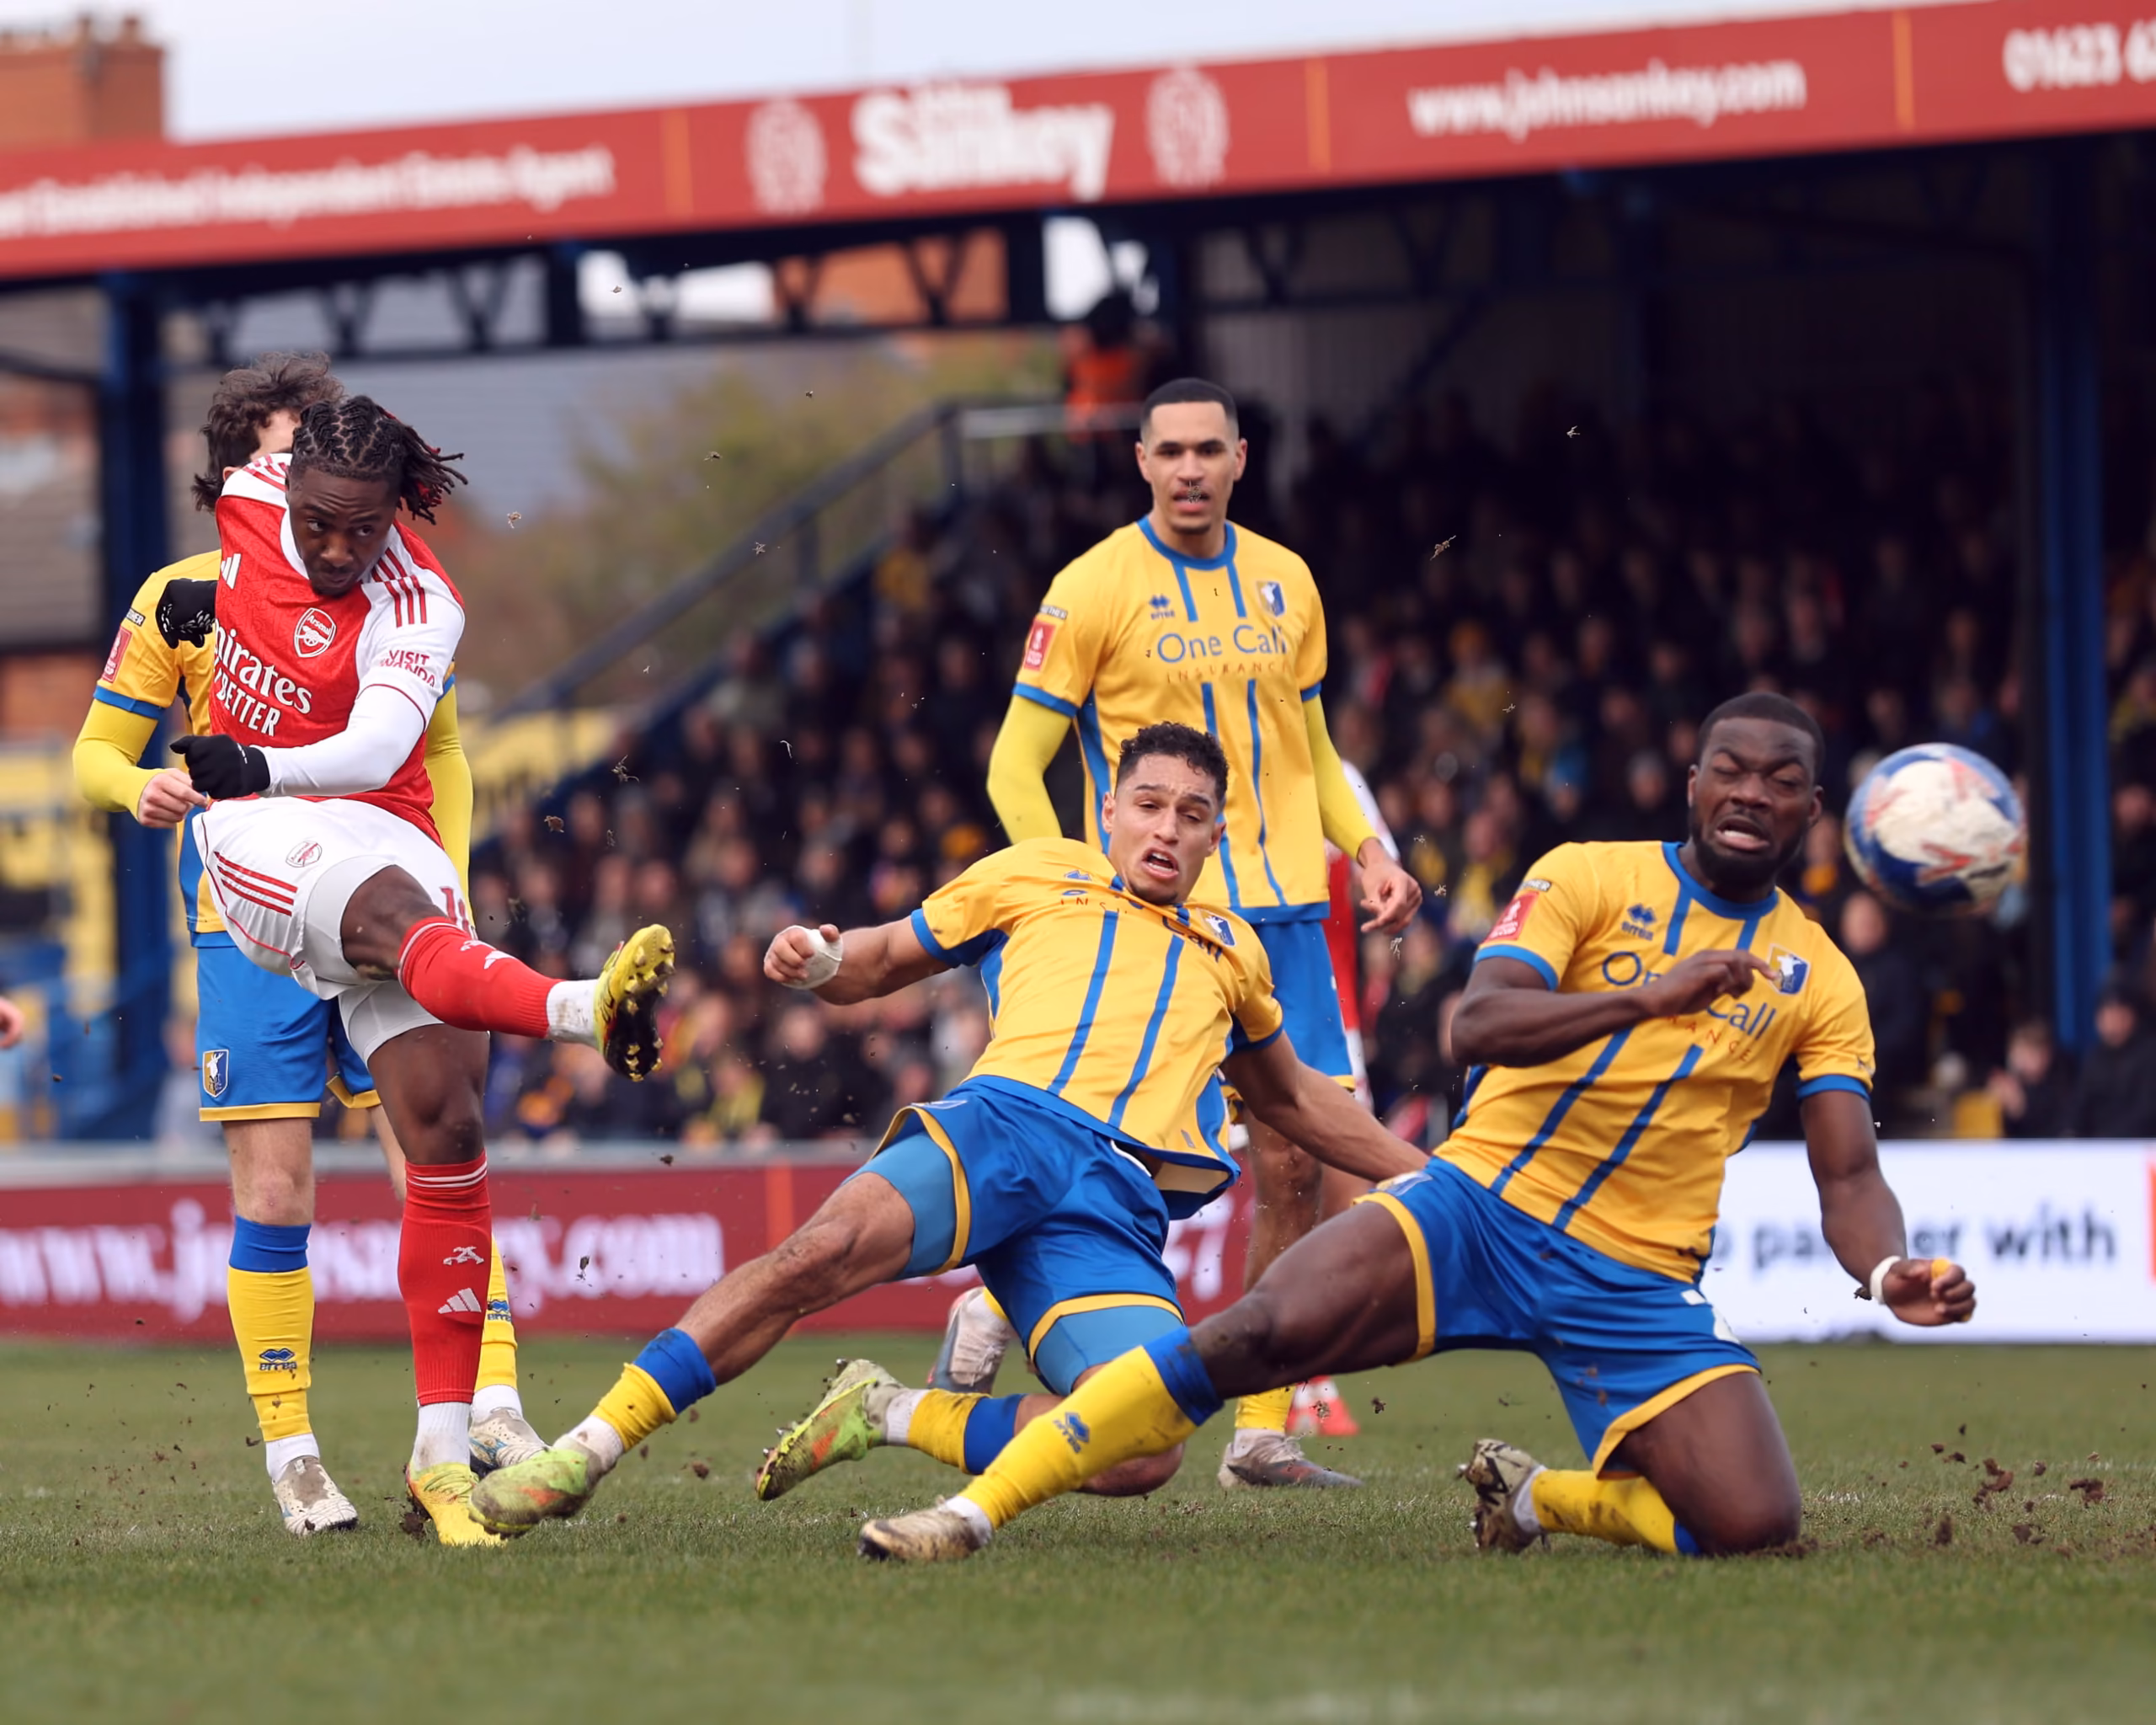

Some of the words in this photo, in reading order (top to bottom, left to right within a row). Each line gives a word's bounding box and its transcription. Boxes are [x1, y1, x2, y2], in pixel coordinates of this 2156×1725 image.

[215, 617, 312, 714] irates
[1157, 633, 1222, 663] One
[1233, 624, 1286, 654] Call
[1986, 1199, 2116, 1260] with
